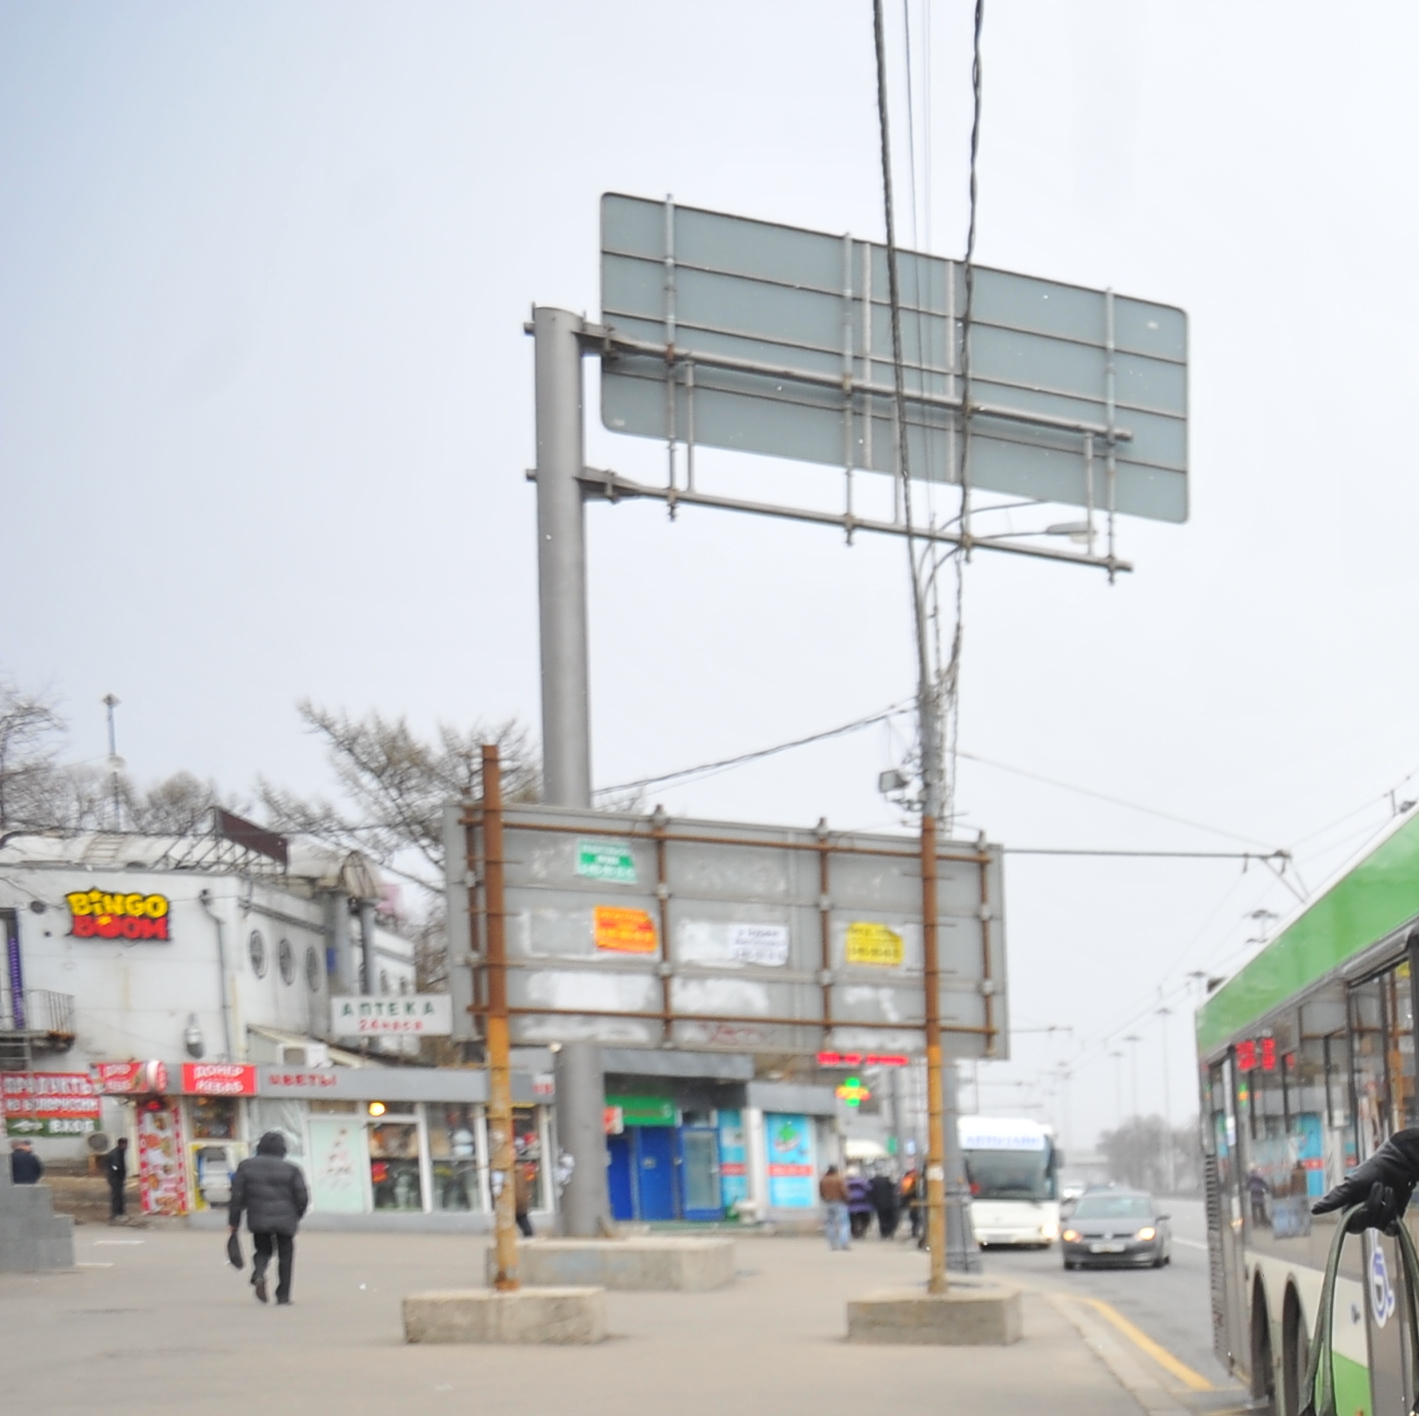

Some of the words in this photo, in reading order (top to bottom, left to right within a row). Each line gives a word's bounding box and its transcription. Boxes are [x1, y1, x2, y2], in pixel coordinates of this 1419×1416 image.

[72, 914, 168, 939] BOOM
[342, 1002, 434, 1017] АПТЕКА
[269, 1073, 337, 1087] ЦВЕТЫ
